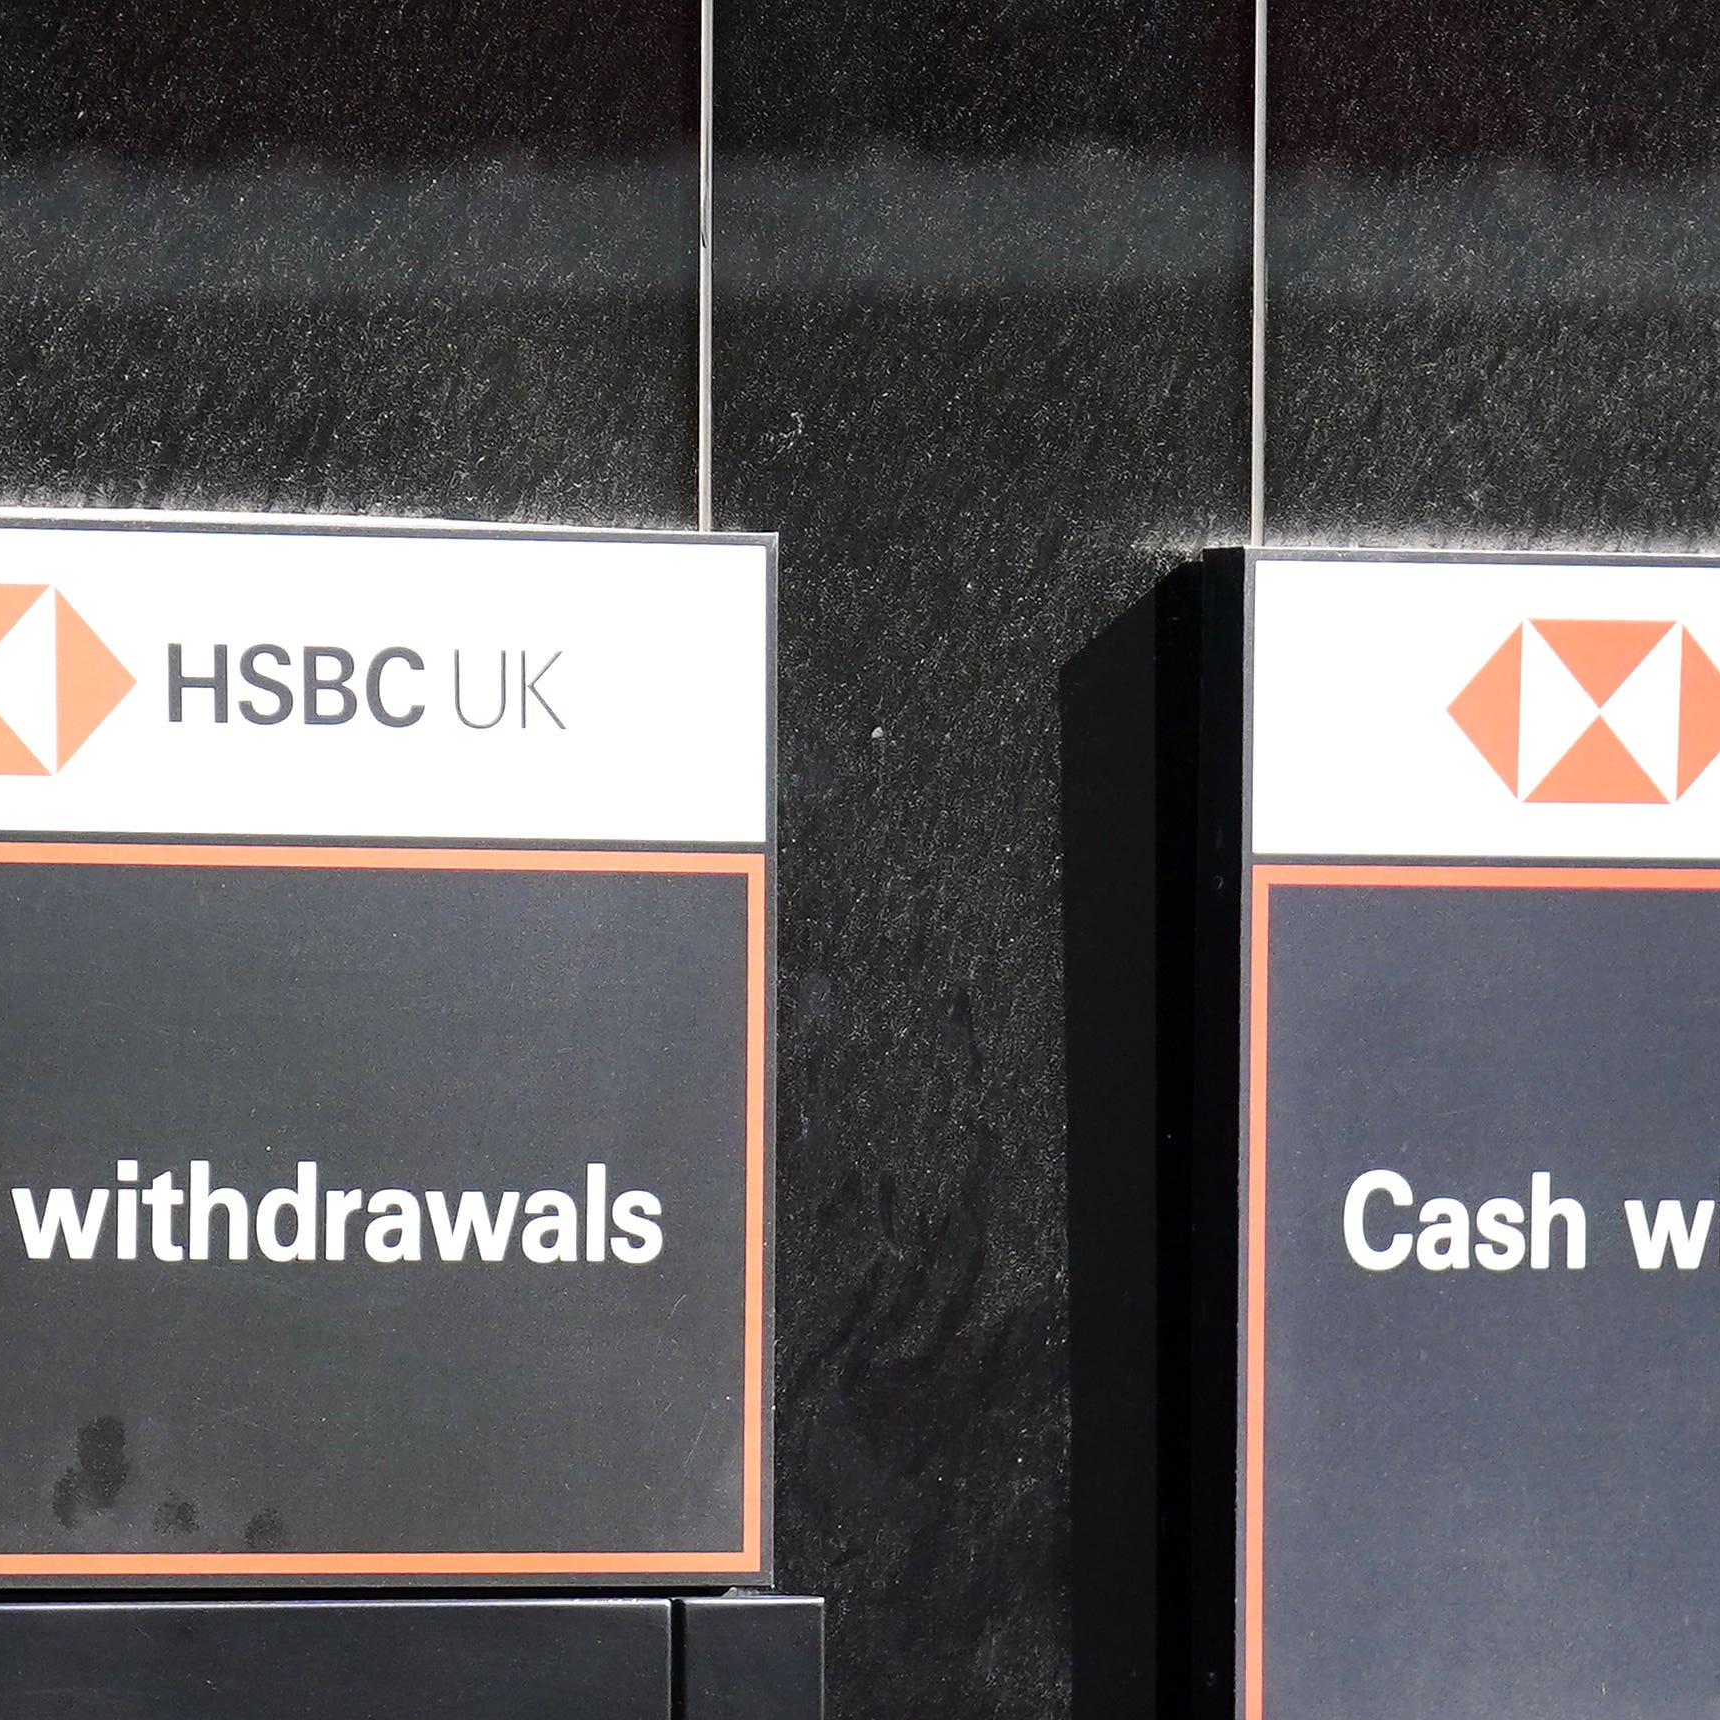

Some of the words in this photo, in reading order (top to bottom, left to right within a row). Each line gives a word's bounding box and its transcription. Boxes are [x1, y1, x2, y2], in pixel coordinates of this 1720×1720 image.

[167, 643, 425, 729] HSBC
[454, 649, 568, 730] UK
[11, 1159, 664, 1265] withdrawals
[1342, 1168, 1587, 1272] Cash
